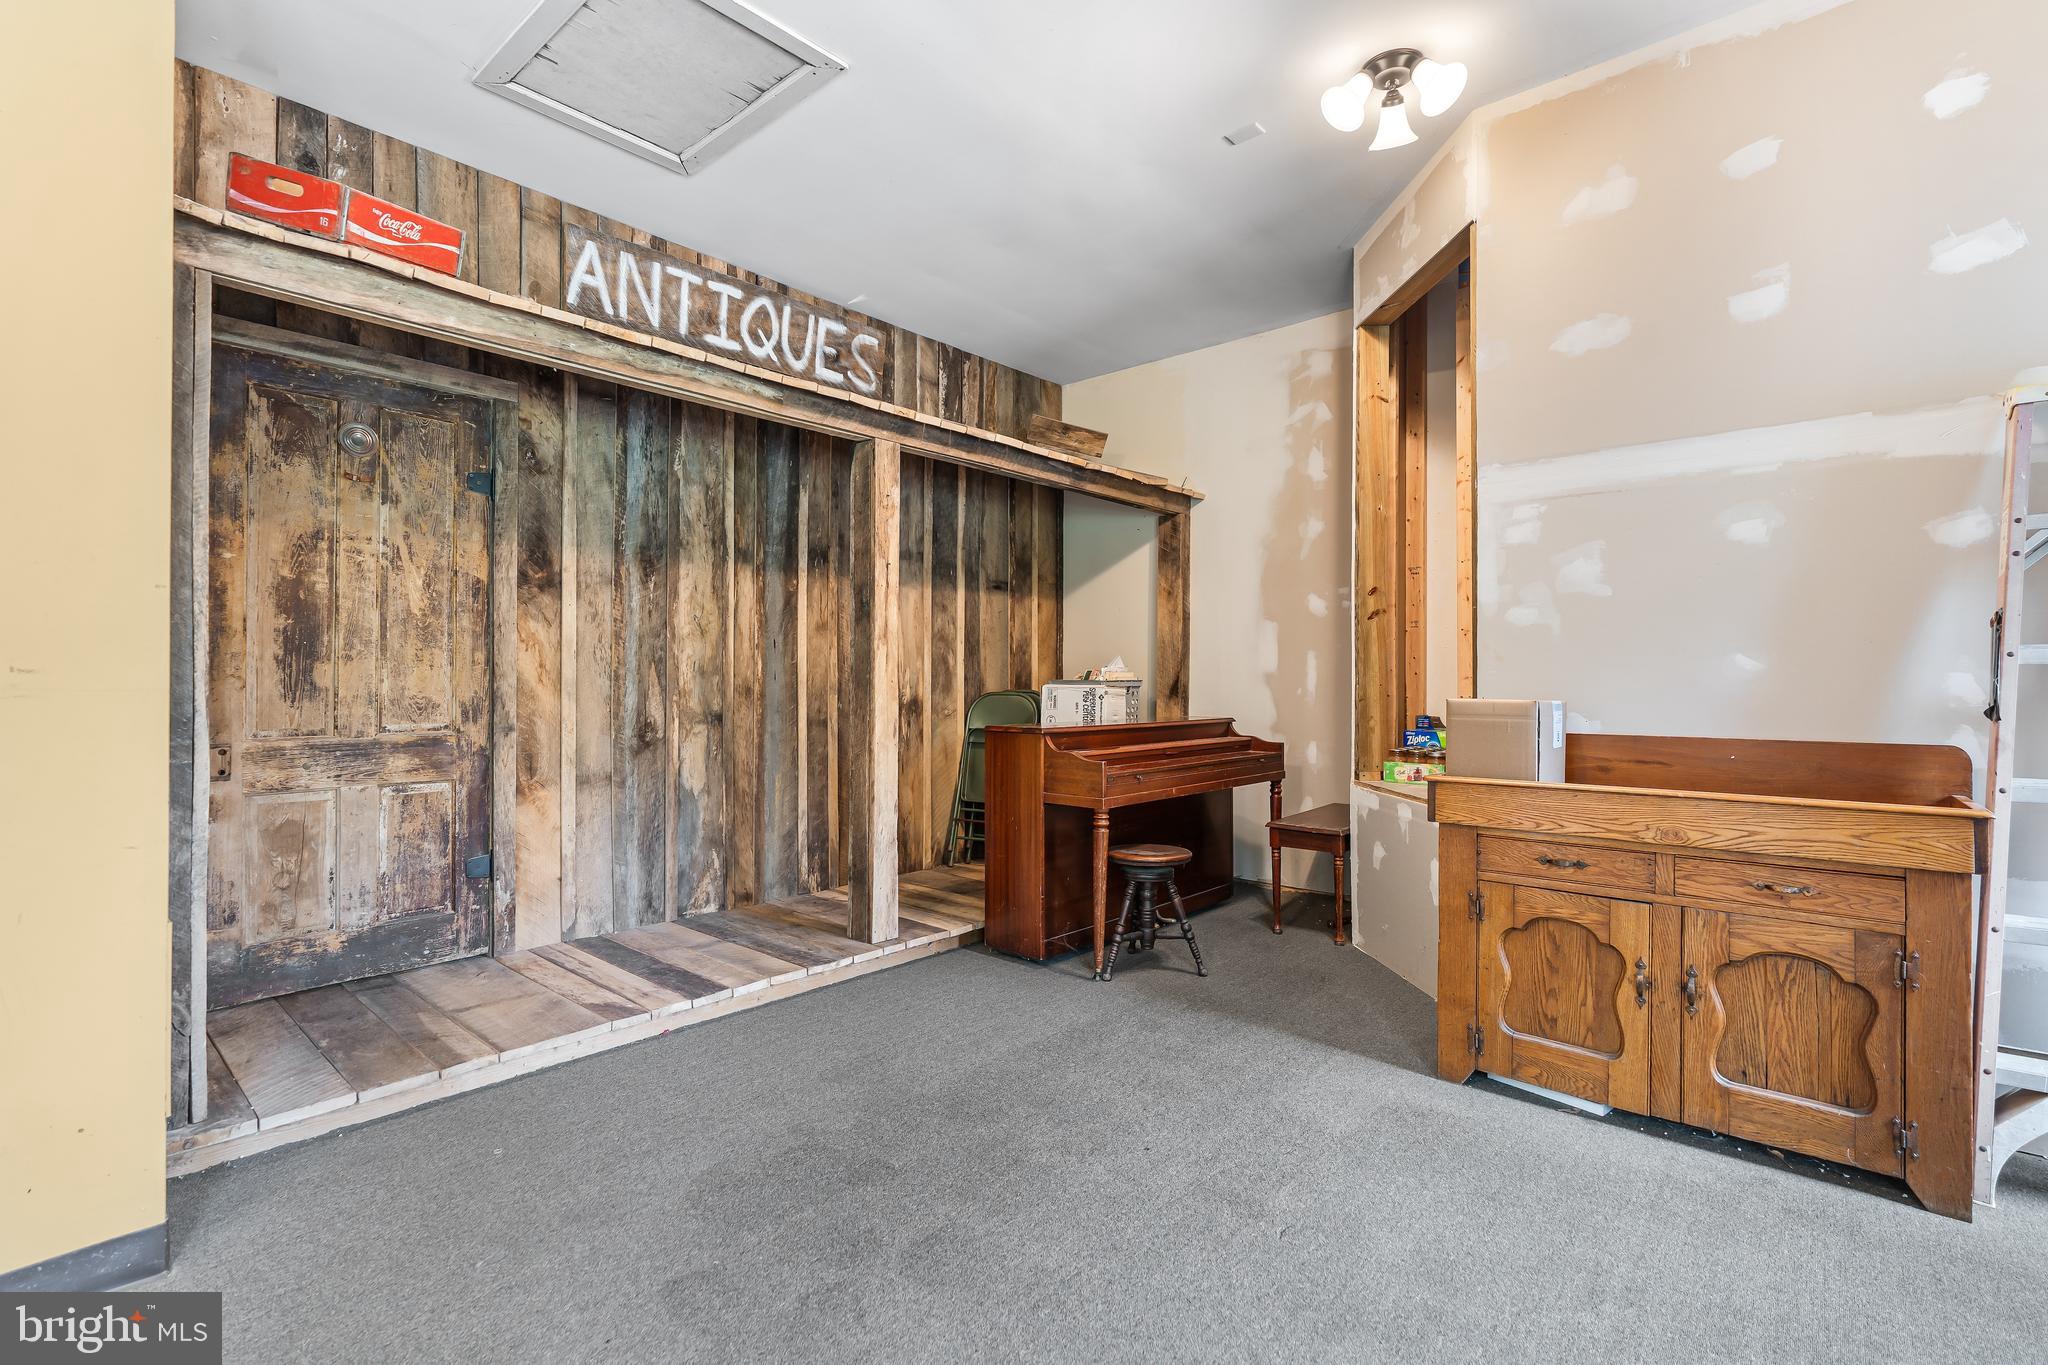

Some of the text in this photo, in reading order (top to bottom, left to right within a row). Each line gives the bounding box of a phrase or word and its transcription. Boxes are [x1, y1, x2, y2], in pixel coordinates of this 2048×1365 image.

[319, 216, 329, 227] 16
[379, 213, 423, 240] Coca-Cola
[566, 240, 879, 394] ANTIQUES
[1406, 735, 1430, 746] Ziploc
